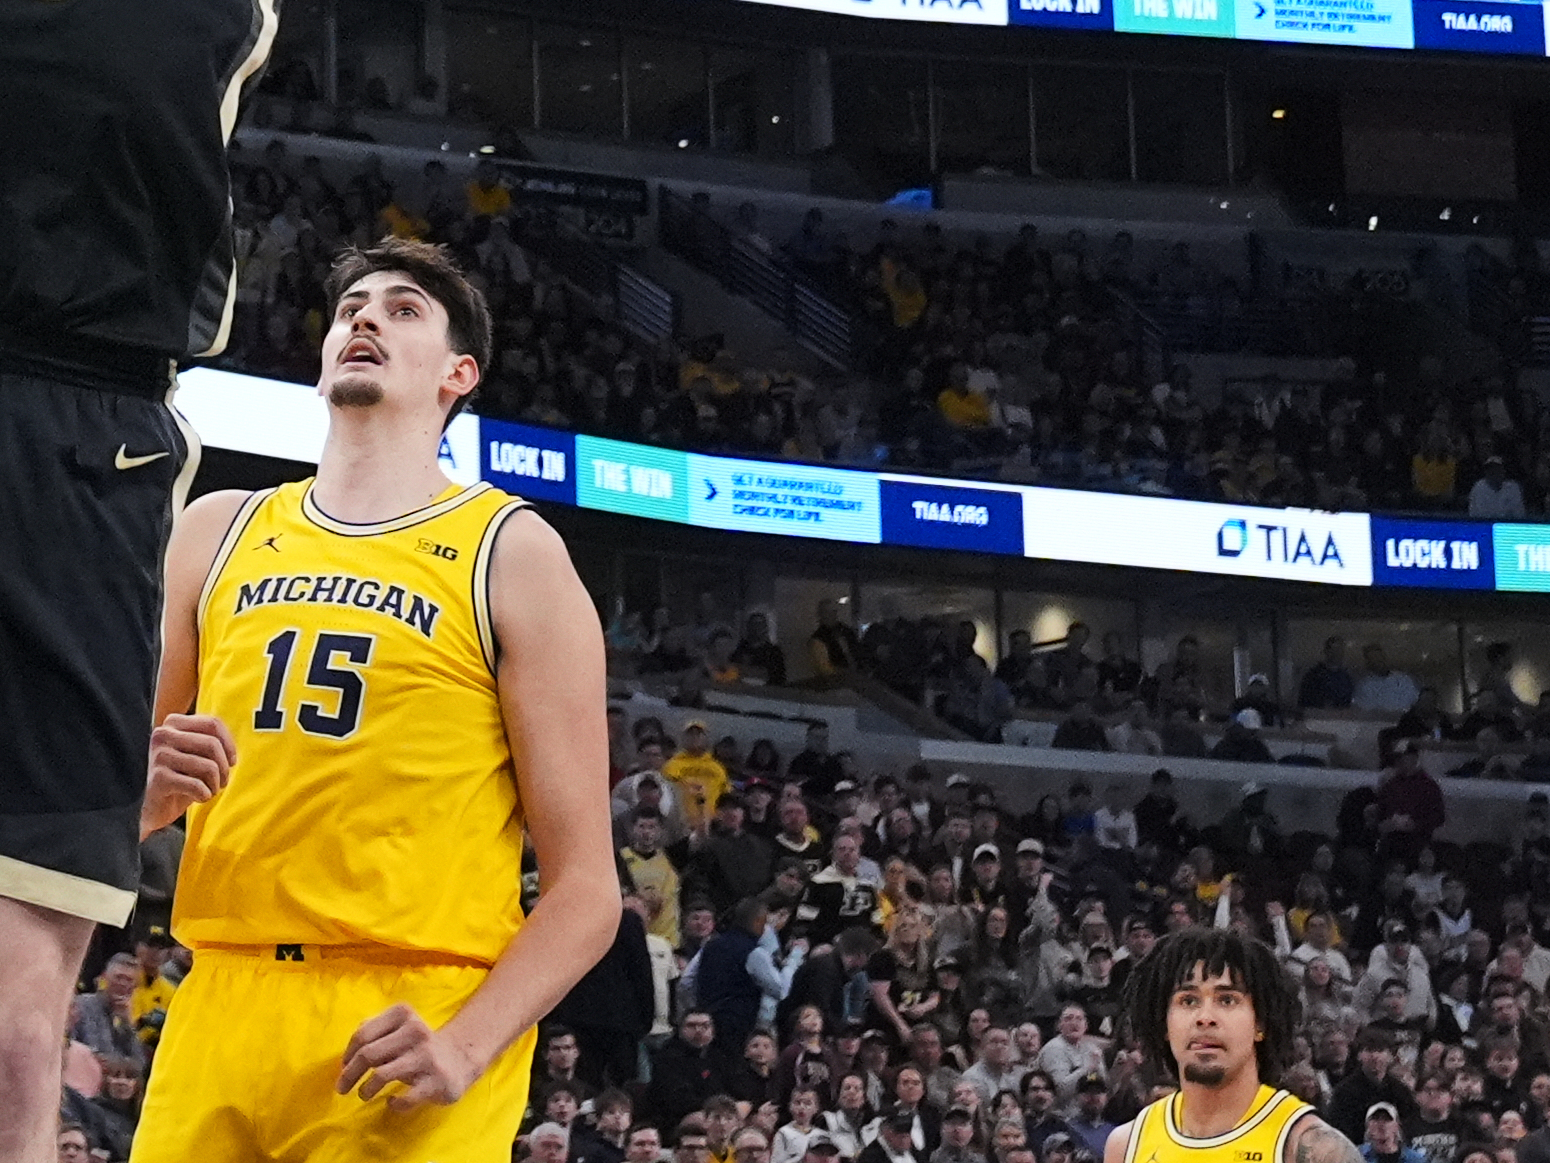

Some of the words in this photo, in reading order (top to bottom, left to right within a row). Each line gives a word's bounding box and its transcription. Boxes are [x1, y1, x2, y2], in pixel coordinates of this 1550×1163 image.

[490, 440, 540, 477] LOCK
[541, 449, 566, 482] IN
[591, 459, 628, 493] THE
[629, 465, 673, 499] WIN
[1255, 524, 1345, 568] TIAA
[1386, 538, 1447, 569] LOCK
[1450, 540, 1480, 570] IN
[233, 574, 441, 641] MICHIGAN
[252, 628, 376, 740] 15
[275, 943, 305, 962] M
